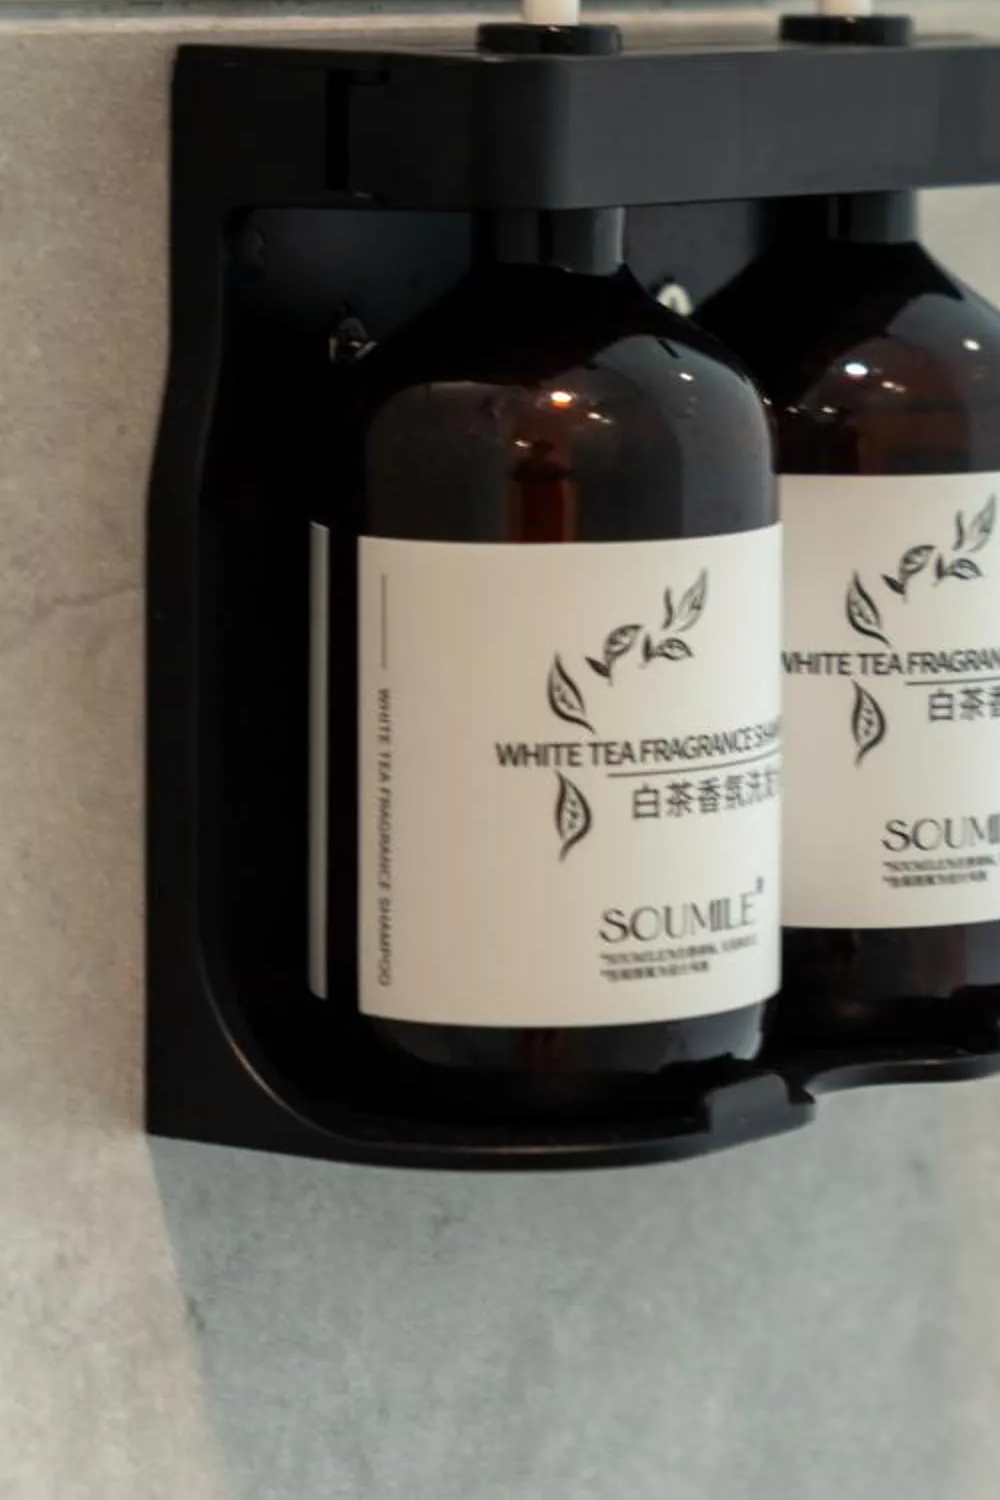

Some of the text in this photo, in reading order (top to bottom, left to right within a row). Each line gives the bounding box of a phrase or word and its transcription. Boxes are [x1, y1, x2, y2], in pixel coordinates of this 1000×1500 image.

[858, 651, 904, 676] TEA
[495, 741, 583, 768] WHITE
[588, 739, 640, 766] TEA
[639, 727, 752, 763] FRAGRANCE
[377, 688, 392, 988] WHITE TEA FRAGRANCE SHAMPOO
[598, 891, 757, 944] SOUMILE
